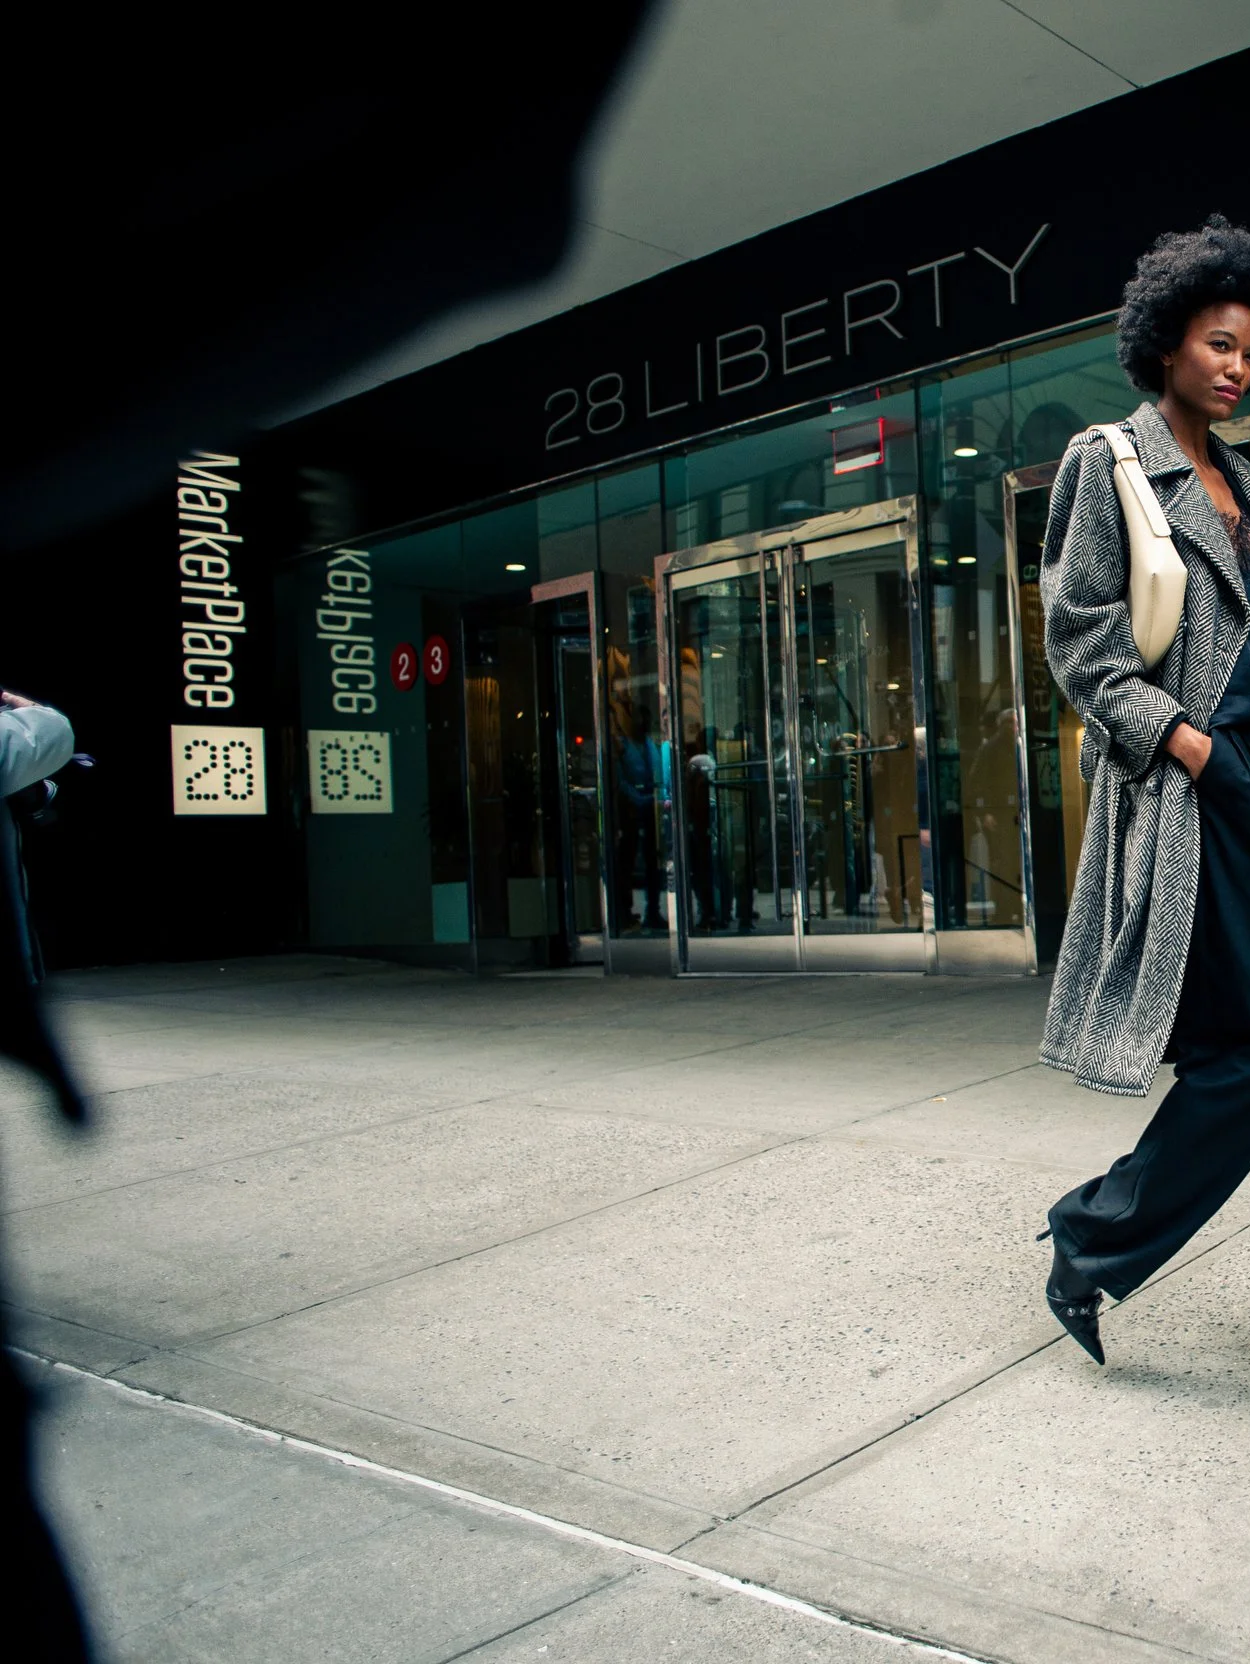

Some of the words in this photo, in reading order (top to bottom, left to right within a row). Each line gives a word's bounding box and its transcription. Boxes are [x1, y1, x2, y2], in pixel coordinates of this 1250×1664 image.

[544, 371, 627, 452] 28
[645, 222, 1050, 419] LIBERTY
[176, 449, 246, 709] MarketPlace
[398, 652, 411, 682] 2
[430, 644, 444, 675] 3
[184, 738, 255, 802] 28
